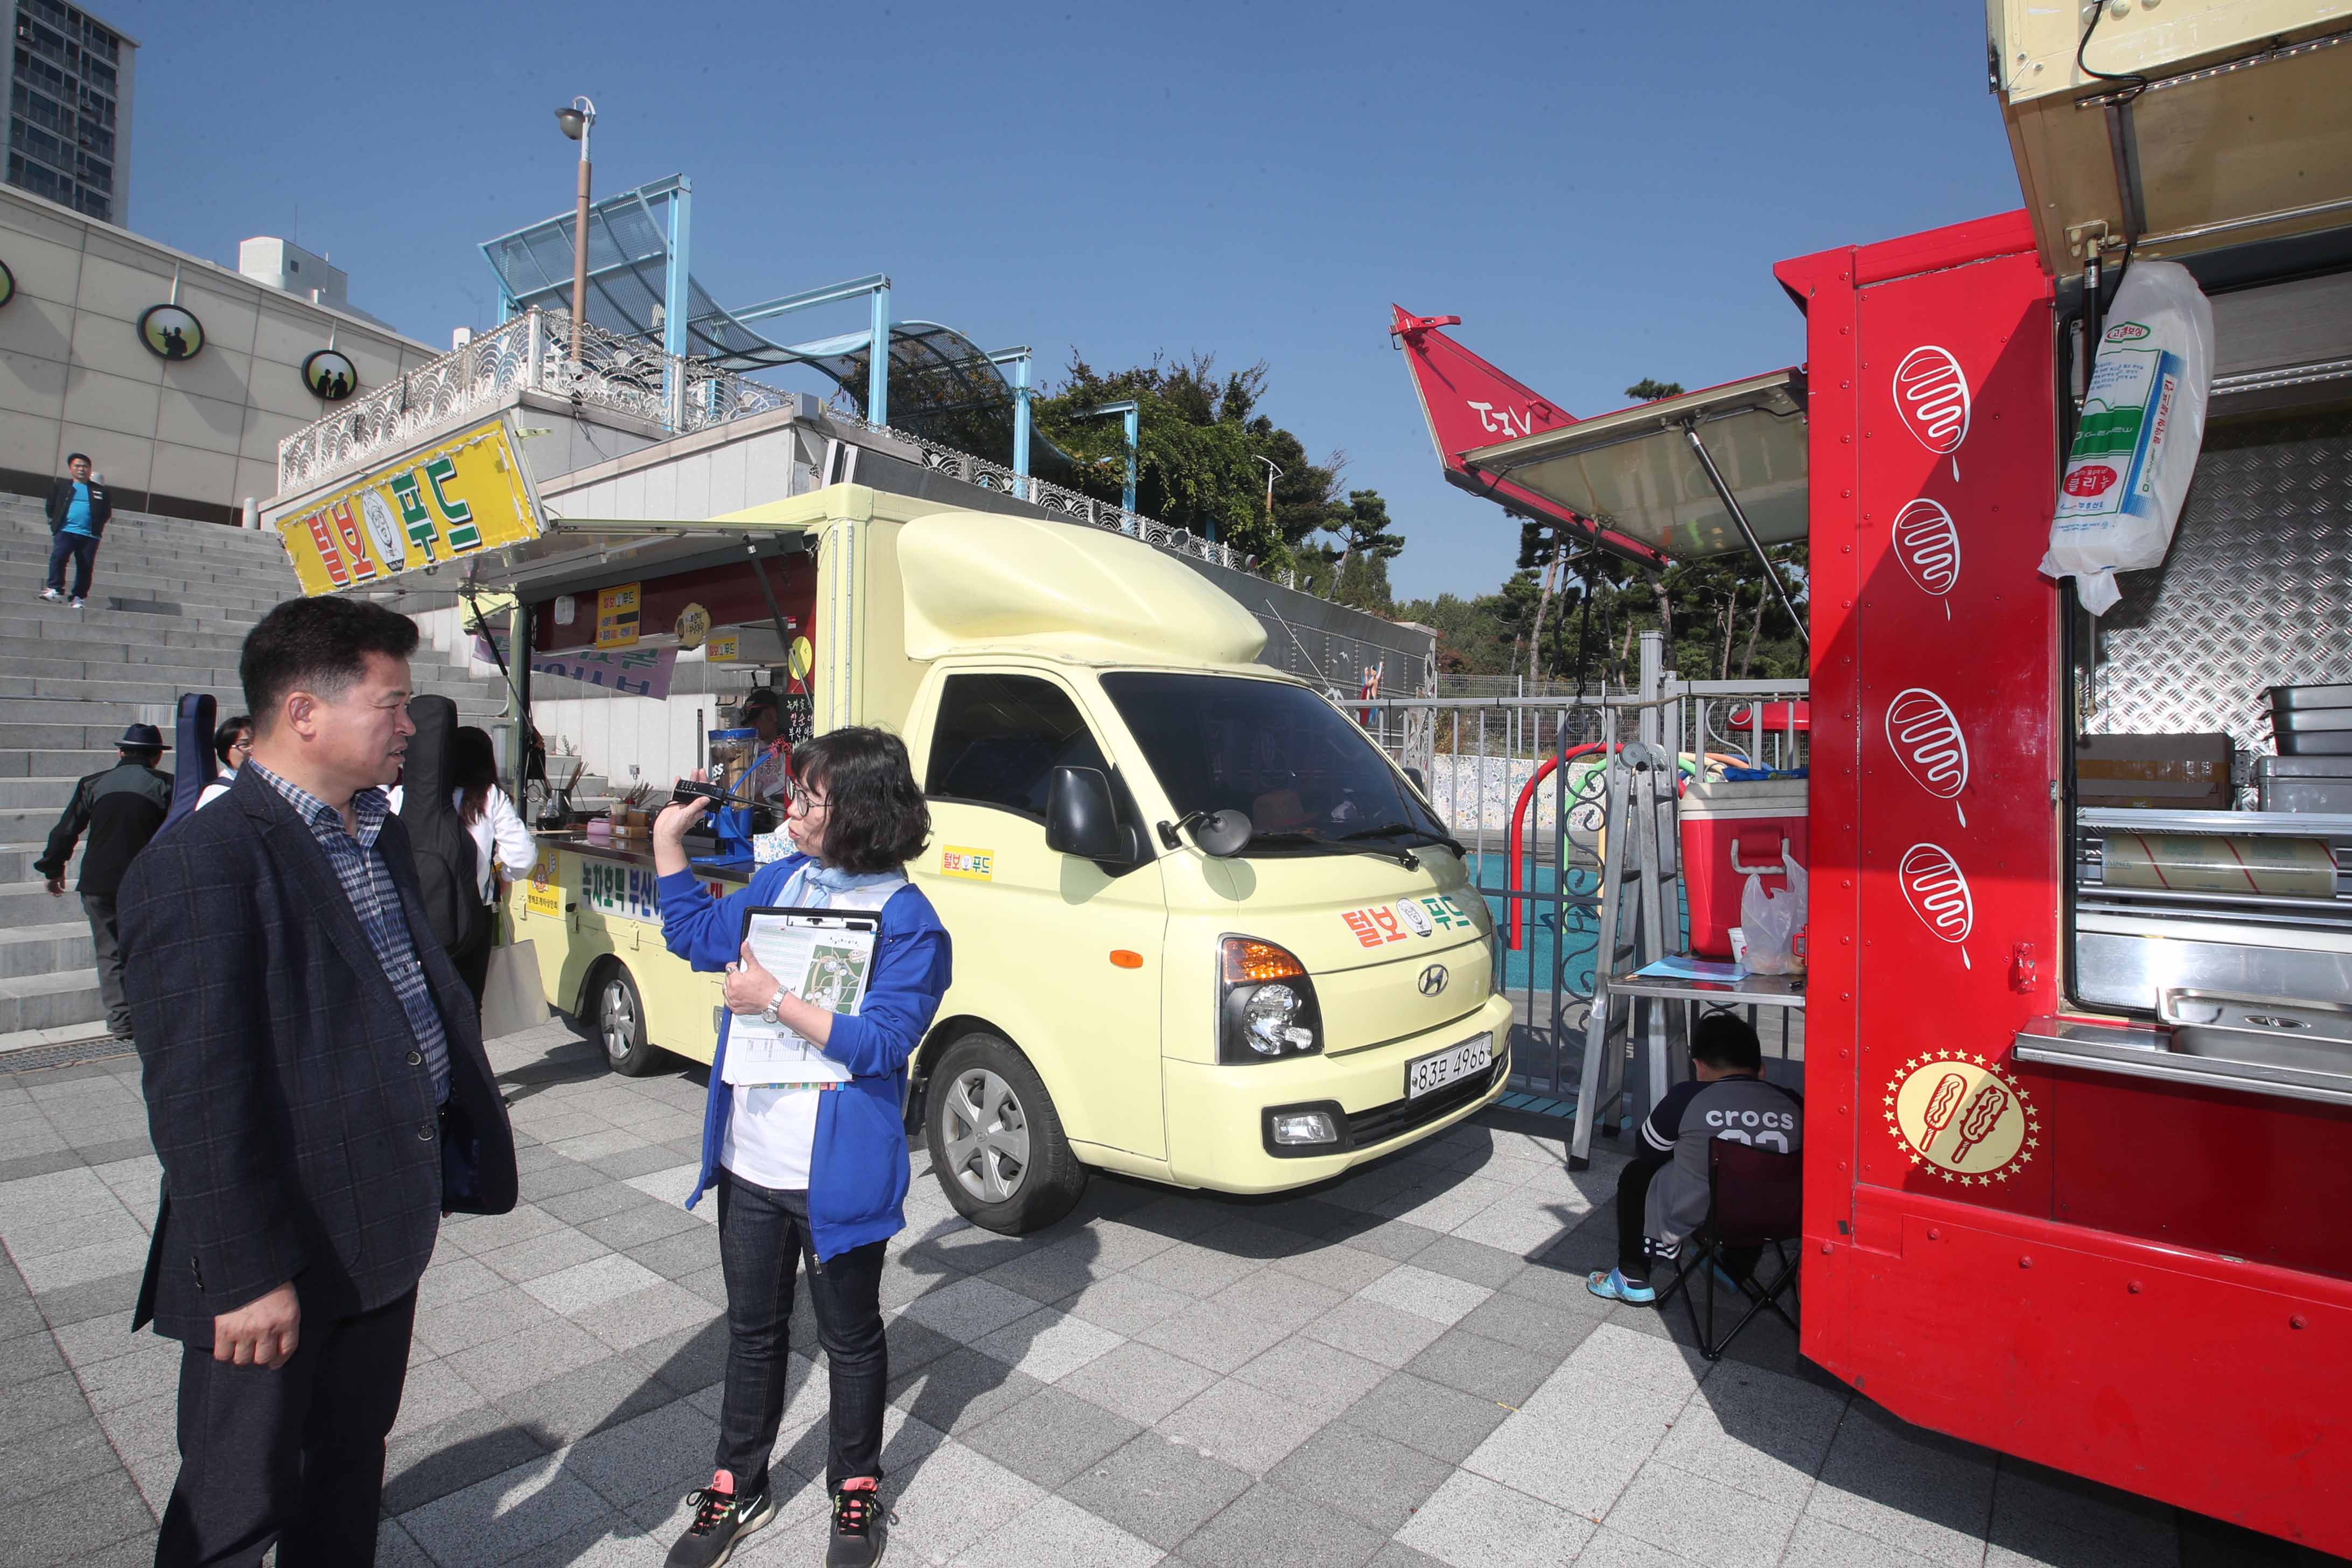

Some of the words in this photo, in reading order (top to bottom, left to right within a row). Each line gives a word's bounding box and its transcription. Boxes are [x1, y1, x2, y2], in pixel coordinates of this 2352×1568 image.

[306, 502, 376, 587] 털보
[389, 456, 481, 561] 푸드
[944, 852, 961, 870] 털보
[972, 856, 990, 873] 푸드
[1341, 906, 1408, 948] 털보
[1420, 896, 1471, 930] 푸드
[1419, 1059, 1447, 1090] 83모
[1453, 1041, 1485, 1075] 4966
[1705, 1110, 1794, 1130] crocs
